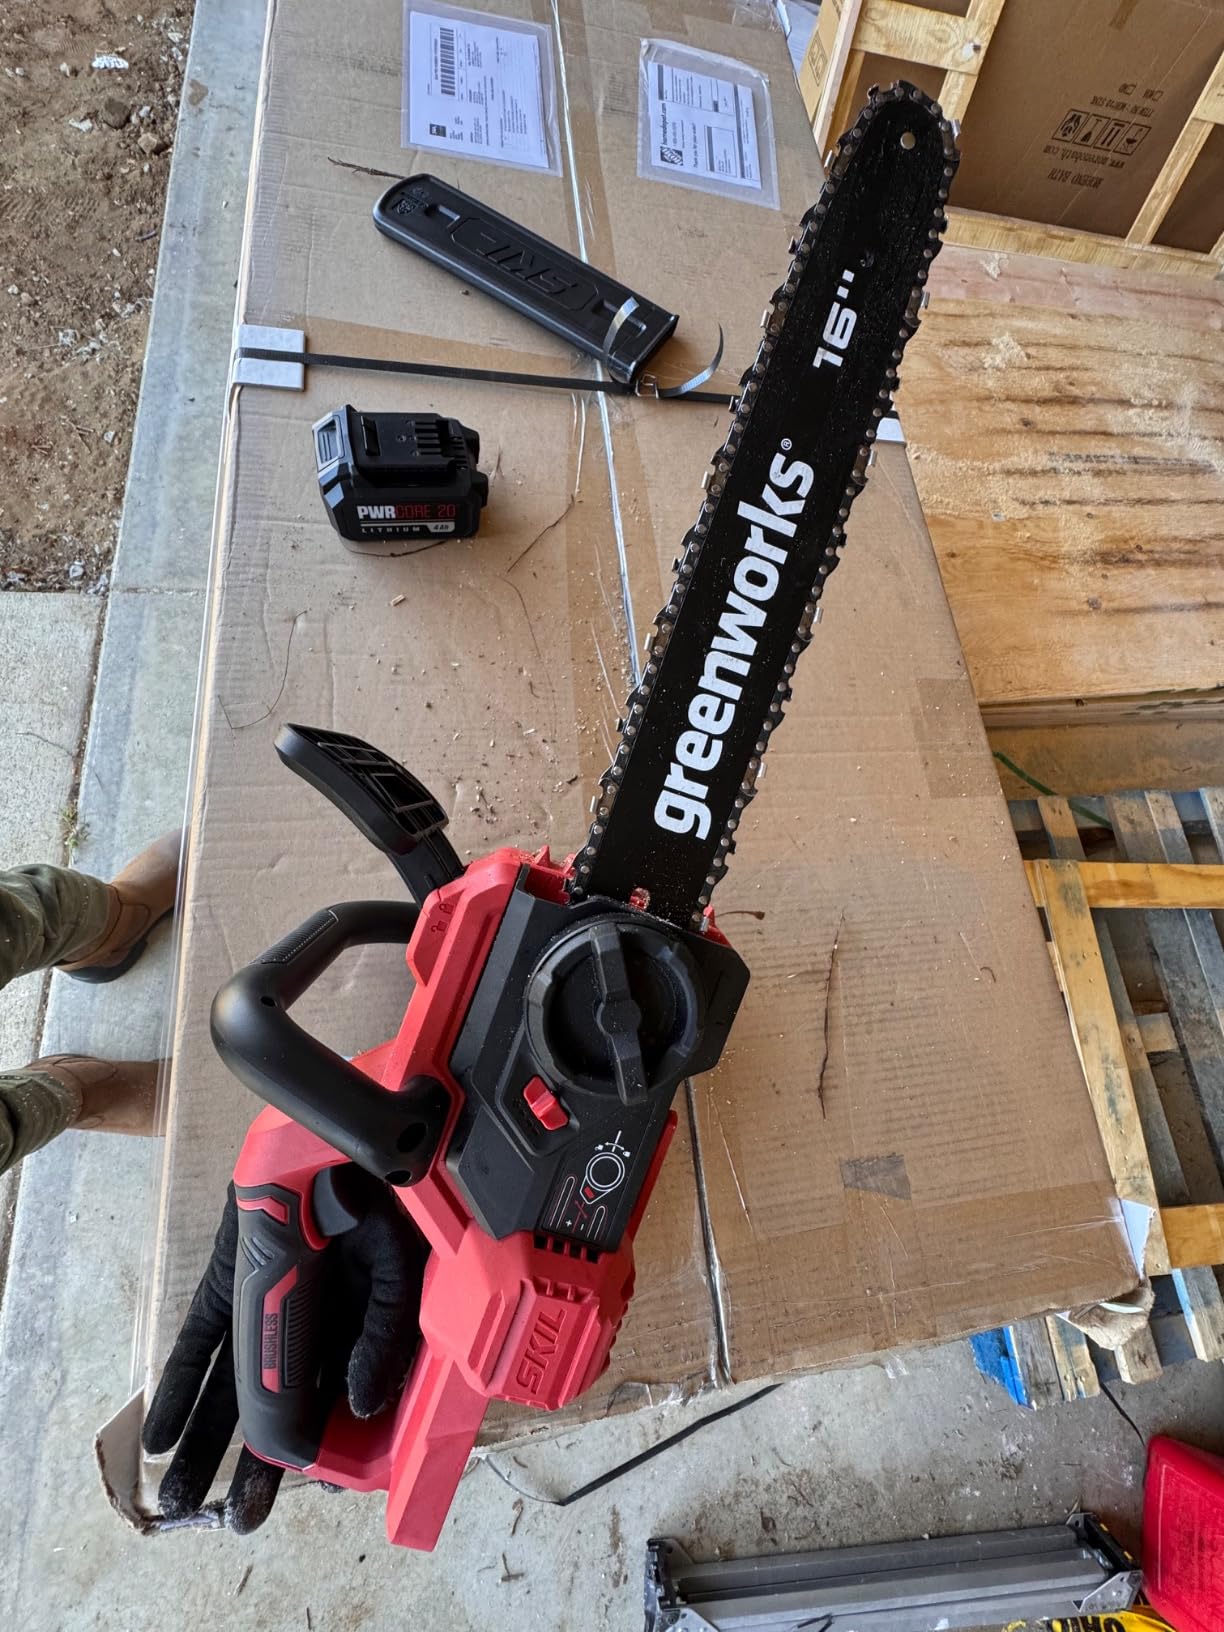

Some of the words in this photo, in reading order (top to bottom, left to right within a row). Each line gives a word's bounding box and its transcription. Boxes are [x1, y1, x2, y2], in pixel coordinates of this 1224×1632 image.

[475, 232, 578, 294] SKIL
[357, 505, 431, 519] PWRCORE
[438, 504, 456, 518] 20
[264, 1313, 279, 1369] BRUSHLESS
[517, 1309, 567, 1395] SKIL
